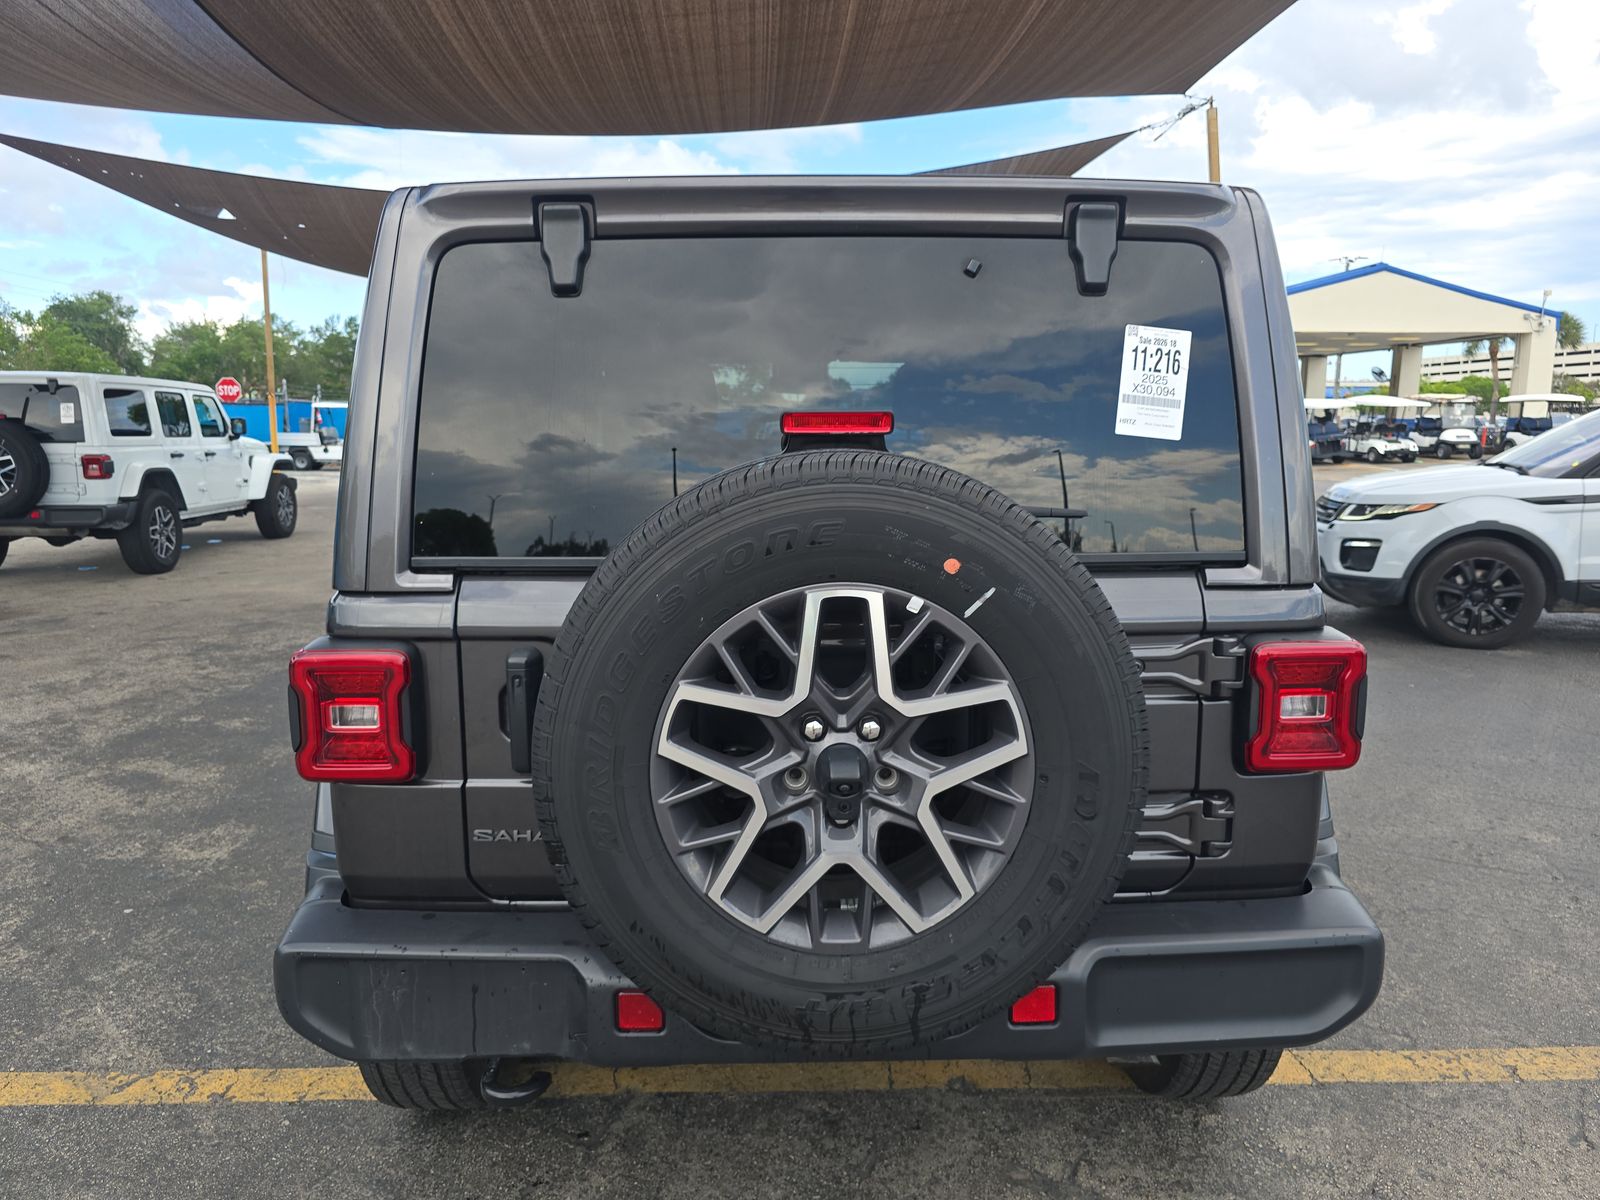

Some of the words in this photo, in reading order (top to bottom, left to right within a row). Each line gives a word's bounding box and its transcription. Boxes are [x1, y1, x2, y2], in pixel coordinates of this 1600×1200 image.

[1139, 336, 1151, 345] Sale
[1132, 345, 1181, 375] 11:216
[1141, 374, 1168, 386] 2025
[218, 385, 239, 396] STOP
[1132, 383, 1175, 397] X30,094
[584, 518, 847, 853] BRIDGESTONE
